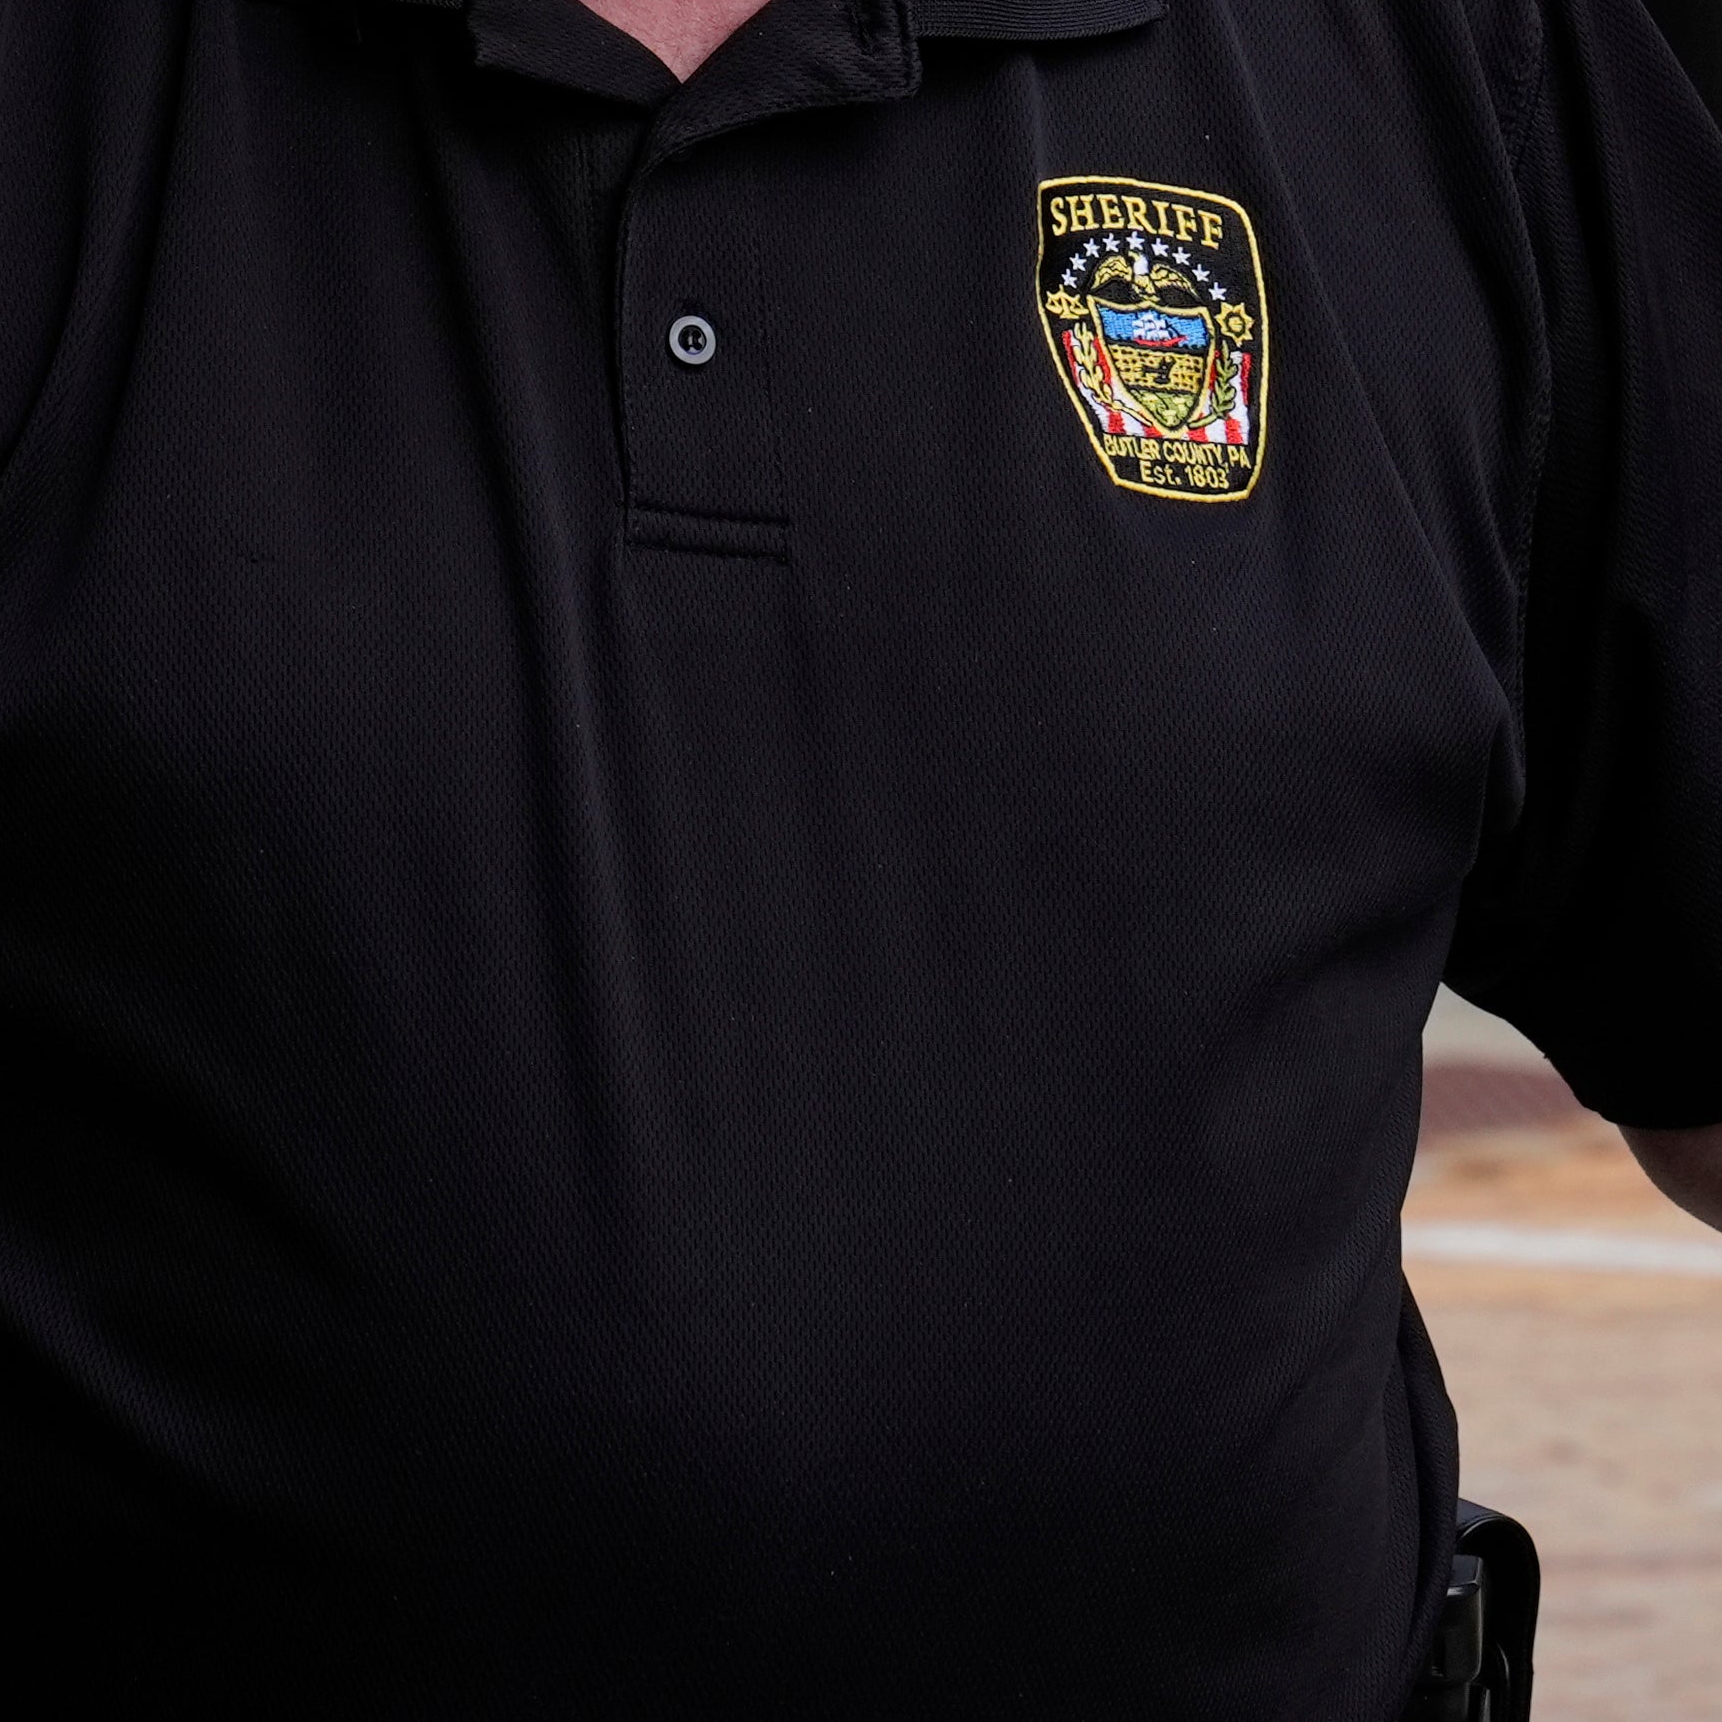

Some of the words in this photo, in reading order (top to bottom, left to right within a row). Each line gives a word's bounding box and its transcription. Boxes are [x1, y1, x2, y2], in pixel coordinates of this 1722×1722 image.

[1050, 193, 1224, 249] SHERIFF
[1103, 433, 1161, 461] BUTLER
[1227, 445, 1252, 469] PA
[1139, 460, 1182, 485] Est.
[1185, 464, 1230, 489] 1803
